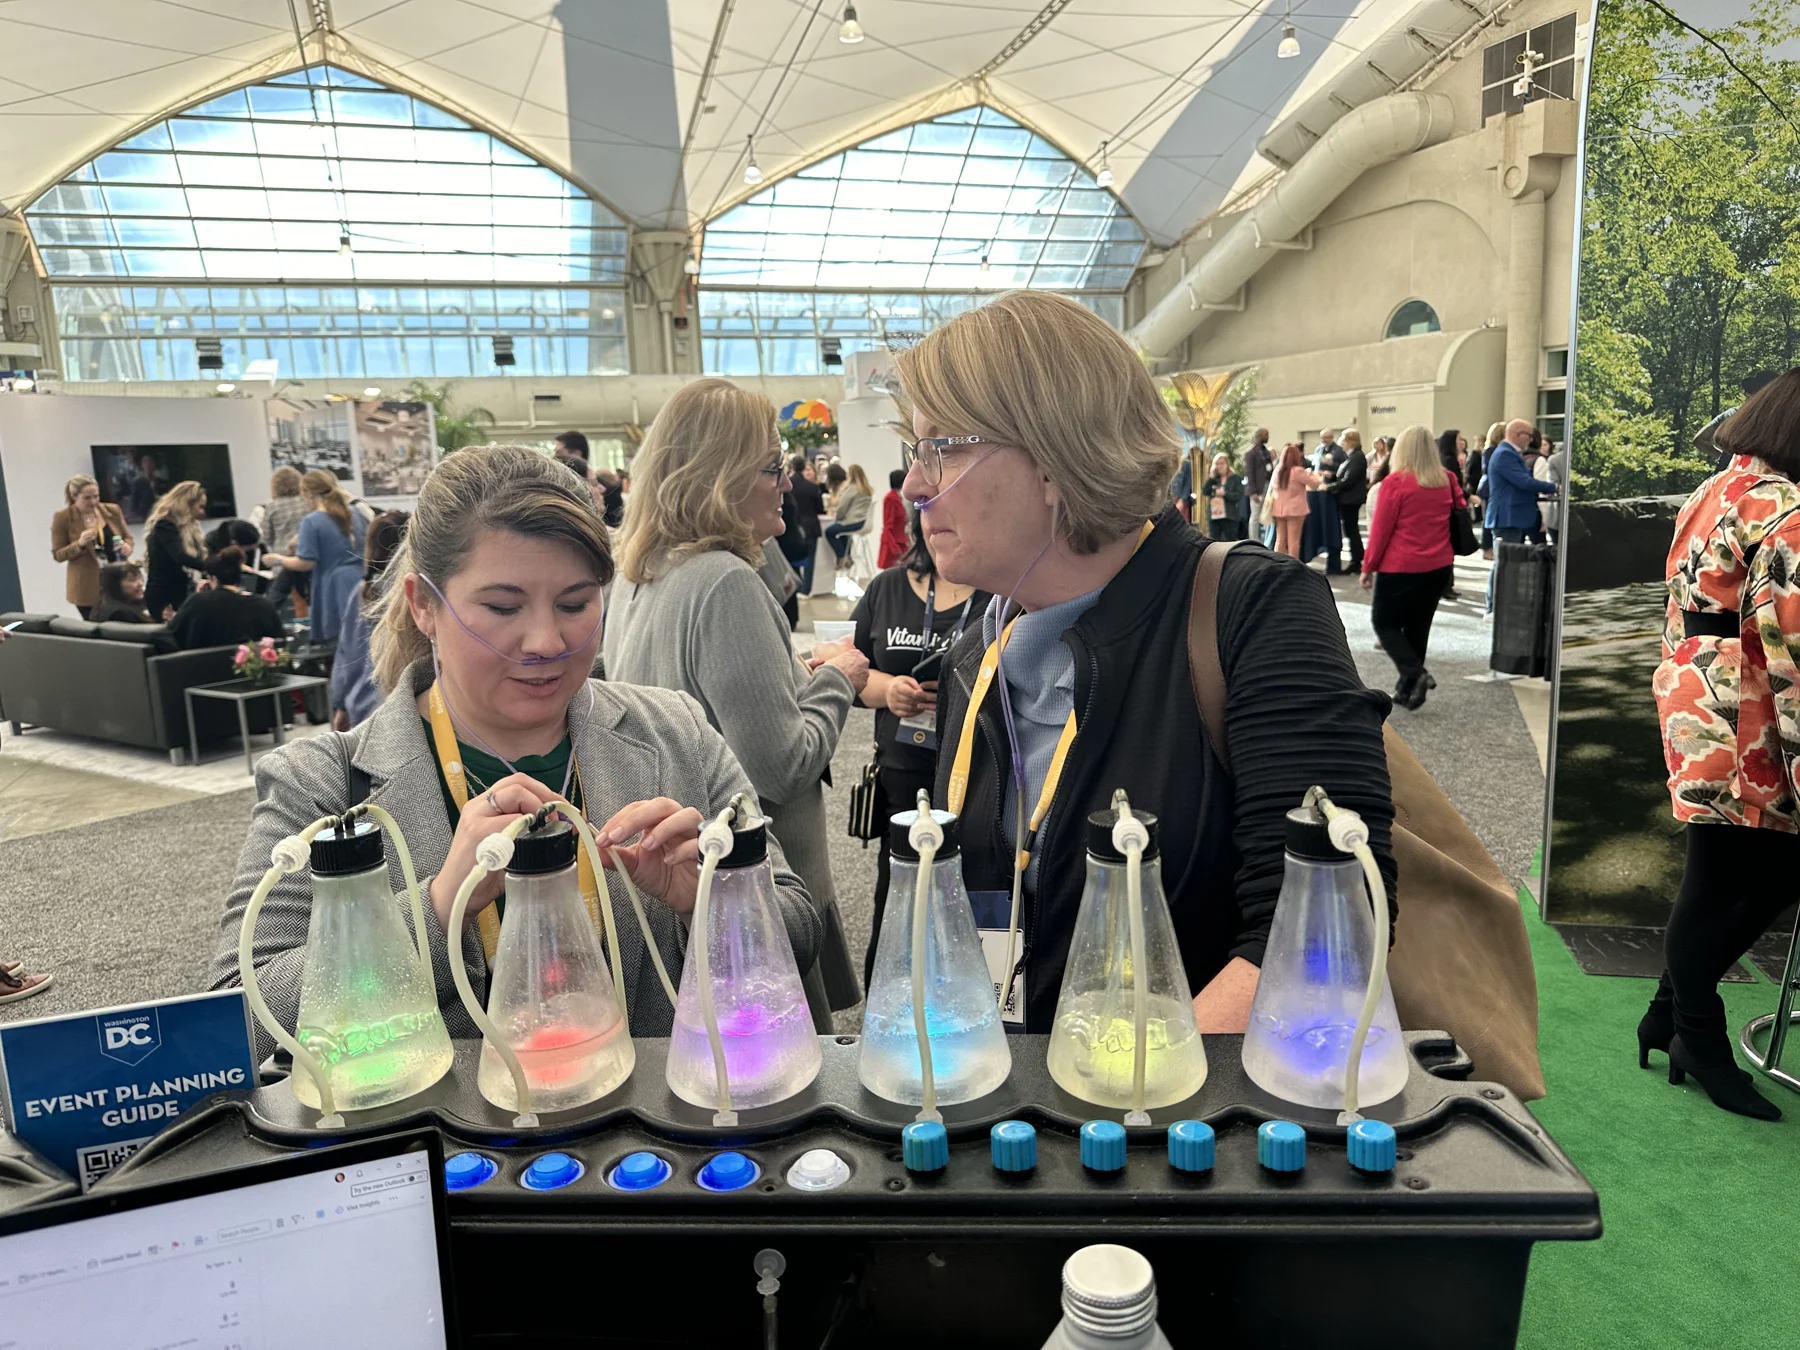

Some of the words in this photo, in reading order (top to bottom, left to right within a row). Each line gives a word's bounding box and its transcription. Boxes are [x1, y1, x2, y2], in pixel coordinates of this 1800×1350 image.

[1370, 405, 1396, 415] Women
[105, 1023, 152, 1049] DC
[25, 1089, 108, 1118] EVENT
[115, 1068, 245, 1102] PLANNING
[102, 1100, 180, 1127] GUIDE
[384, 1178, 405, 1187] Outlook
